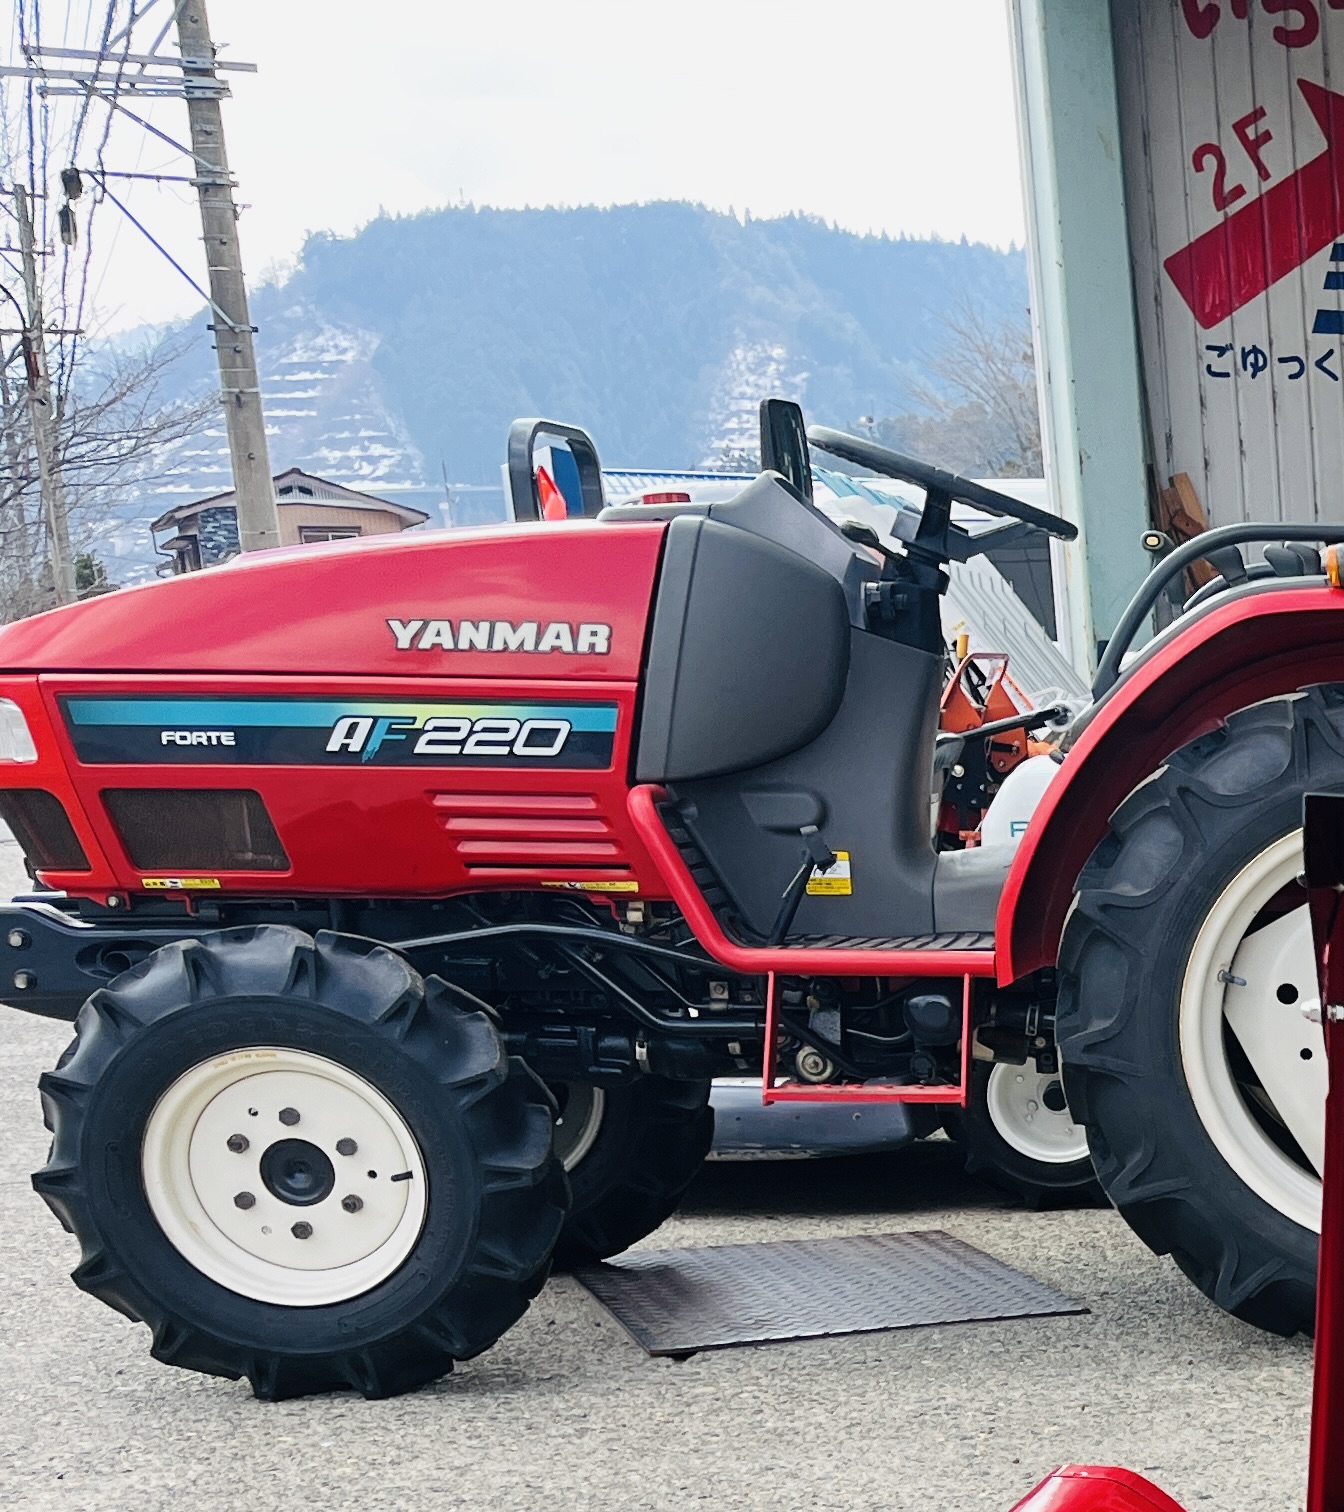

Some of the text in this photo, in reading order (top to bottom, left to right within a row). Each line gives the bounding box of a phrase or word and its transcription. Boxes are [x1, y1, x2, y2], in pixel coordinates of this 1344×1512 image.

[1192, 105, 1274, 212] 2F
[388, 618, 611, 654] YANMAR
[161, 730, 236, 747] FORTE
[326, 714, 573, 762] AF220
